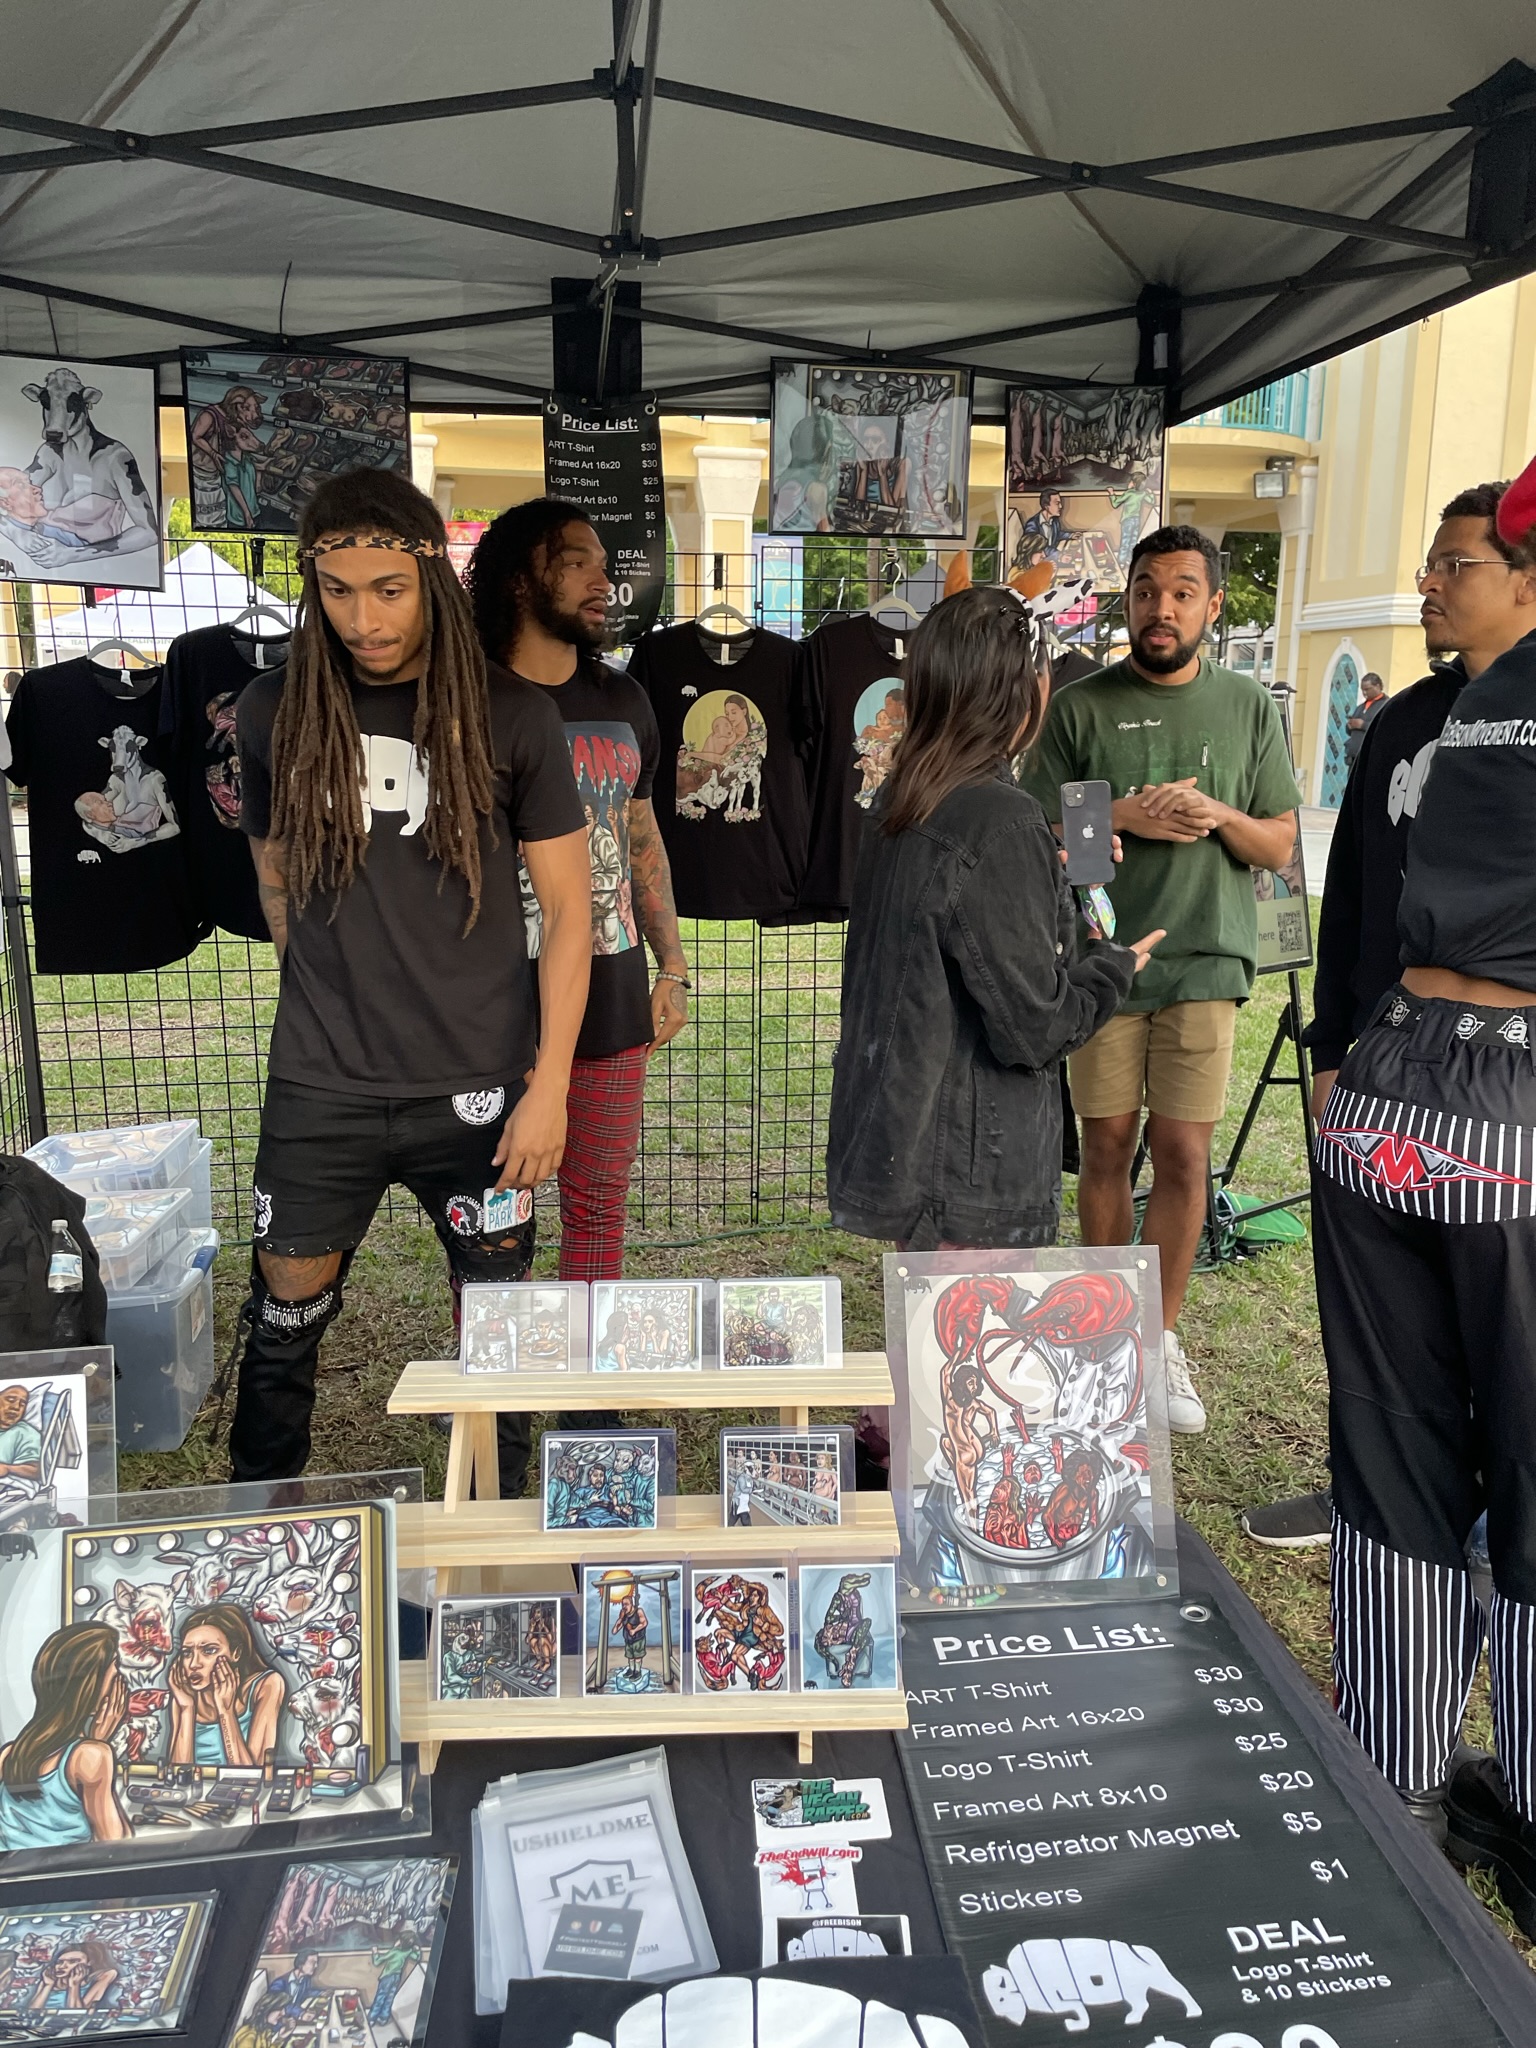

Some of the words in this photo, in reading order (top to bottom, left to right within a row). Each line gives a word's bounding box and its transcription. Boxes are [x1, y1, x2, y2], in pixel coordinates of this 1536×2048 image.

[562, 414, 600, 431] Price
[605, 417, 638, 430] List:
[548, 440, 566, 450] ART
[567, 442, 595, 453] T-Shirt
[640, 443, 657, 452] $30
[549, 457, 580, 468] Framed
[581, 461, 594, 469] Art
[596, 461, 621, 469] 16x20
[641, 460, 658, 468] $30
[550, 475, 571, 486] Logo
[572, 477, 600, 487] T-Shirt
[642, 477, 659, 486] $25
[583, 496, 596, 504] Art
[597, 496, 618, 505] 8x10
[644, 494, 660, 503] $20
[601, 512, 633, 523] Magnet
[645, 511, 656, 520] $5
[646, 529, 656, 538] $1
[617, 549, 647, 559] DEAL
[488, 1206, 513, 1231] PARK
[264, 1305, 301, 1327] EMOTIONAL
[932, 1634, 1052, 1662] Price
[1062, 1622, 1167, 1651] List:
[905, 1687, 957, 1705] ART
[964, 1680, 1053, 1700] T-Shirt
[1194, 1665, 1243, 1686] $30
[911, 1717, 1014, 1740] Framed
[1021, 1714, 1060, 1732] Art
[1066, 1706, 1146, 1727] 16x20
[1213, 1696, 1264, 1716] $30
[923, 1761, 993, 1781] Logo
[997, 1749, 1094, 1773] T-Shirt
[1234, 1732, 1288, 1754] $25
[801, 1780, 834, 1795] THE
[933, 1793, 1044, 1821] Framed
[1052, 1790, 1095, 1811] Art
[1098, 1783, 1168, 1806] 8x10
[1259, 1770, 1314, 1793] $20
[801, 1791, 862, 1808] VEGAN
[801, 1803, 869, 1823] RAPPER
[513, 1813, 653, 1854] USHIELDME
[944, 1834, 1119, 1865] Refrigerator
[1126, 1819, 1241, 1849] Magnet
[1282, 1811, 1322, 1835] $5
[571, 1874, 627, 1905] ME
[959, 1886, 1083, 1915] Stickers
[1310, 1858, 1349, 1883] $1
[812, 1919, 862, 1928] @FREEBISON
[1226, 1917, 1347, 1953] DEAL
[1231, 1963, 1293, 1982] Logo
[1294, 1951, 1375, 1976] T-Shirt
[1241, 1987, 1261, 2004] &
[1264, 1984, 1293, 2001] 10
[1296, 1974, 1392, 1998] Stickers
